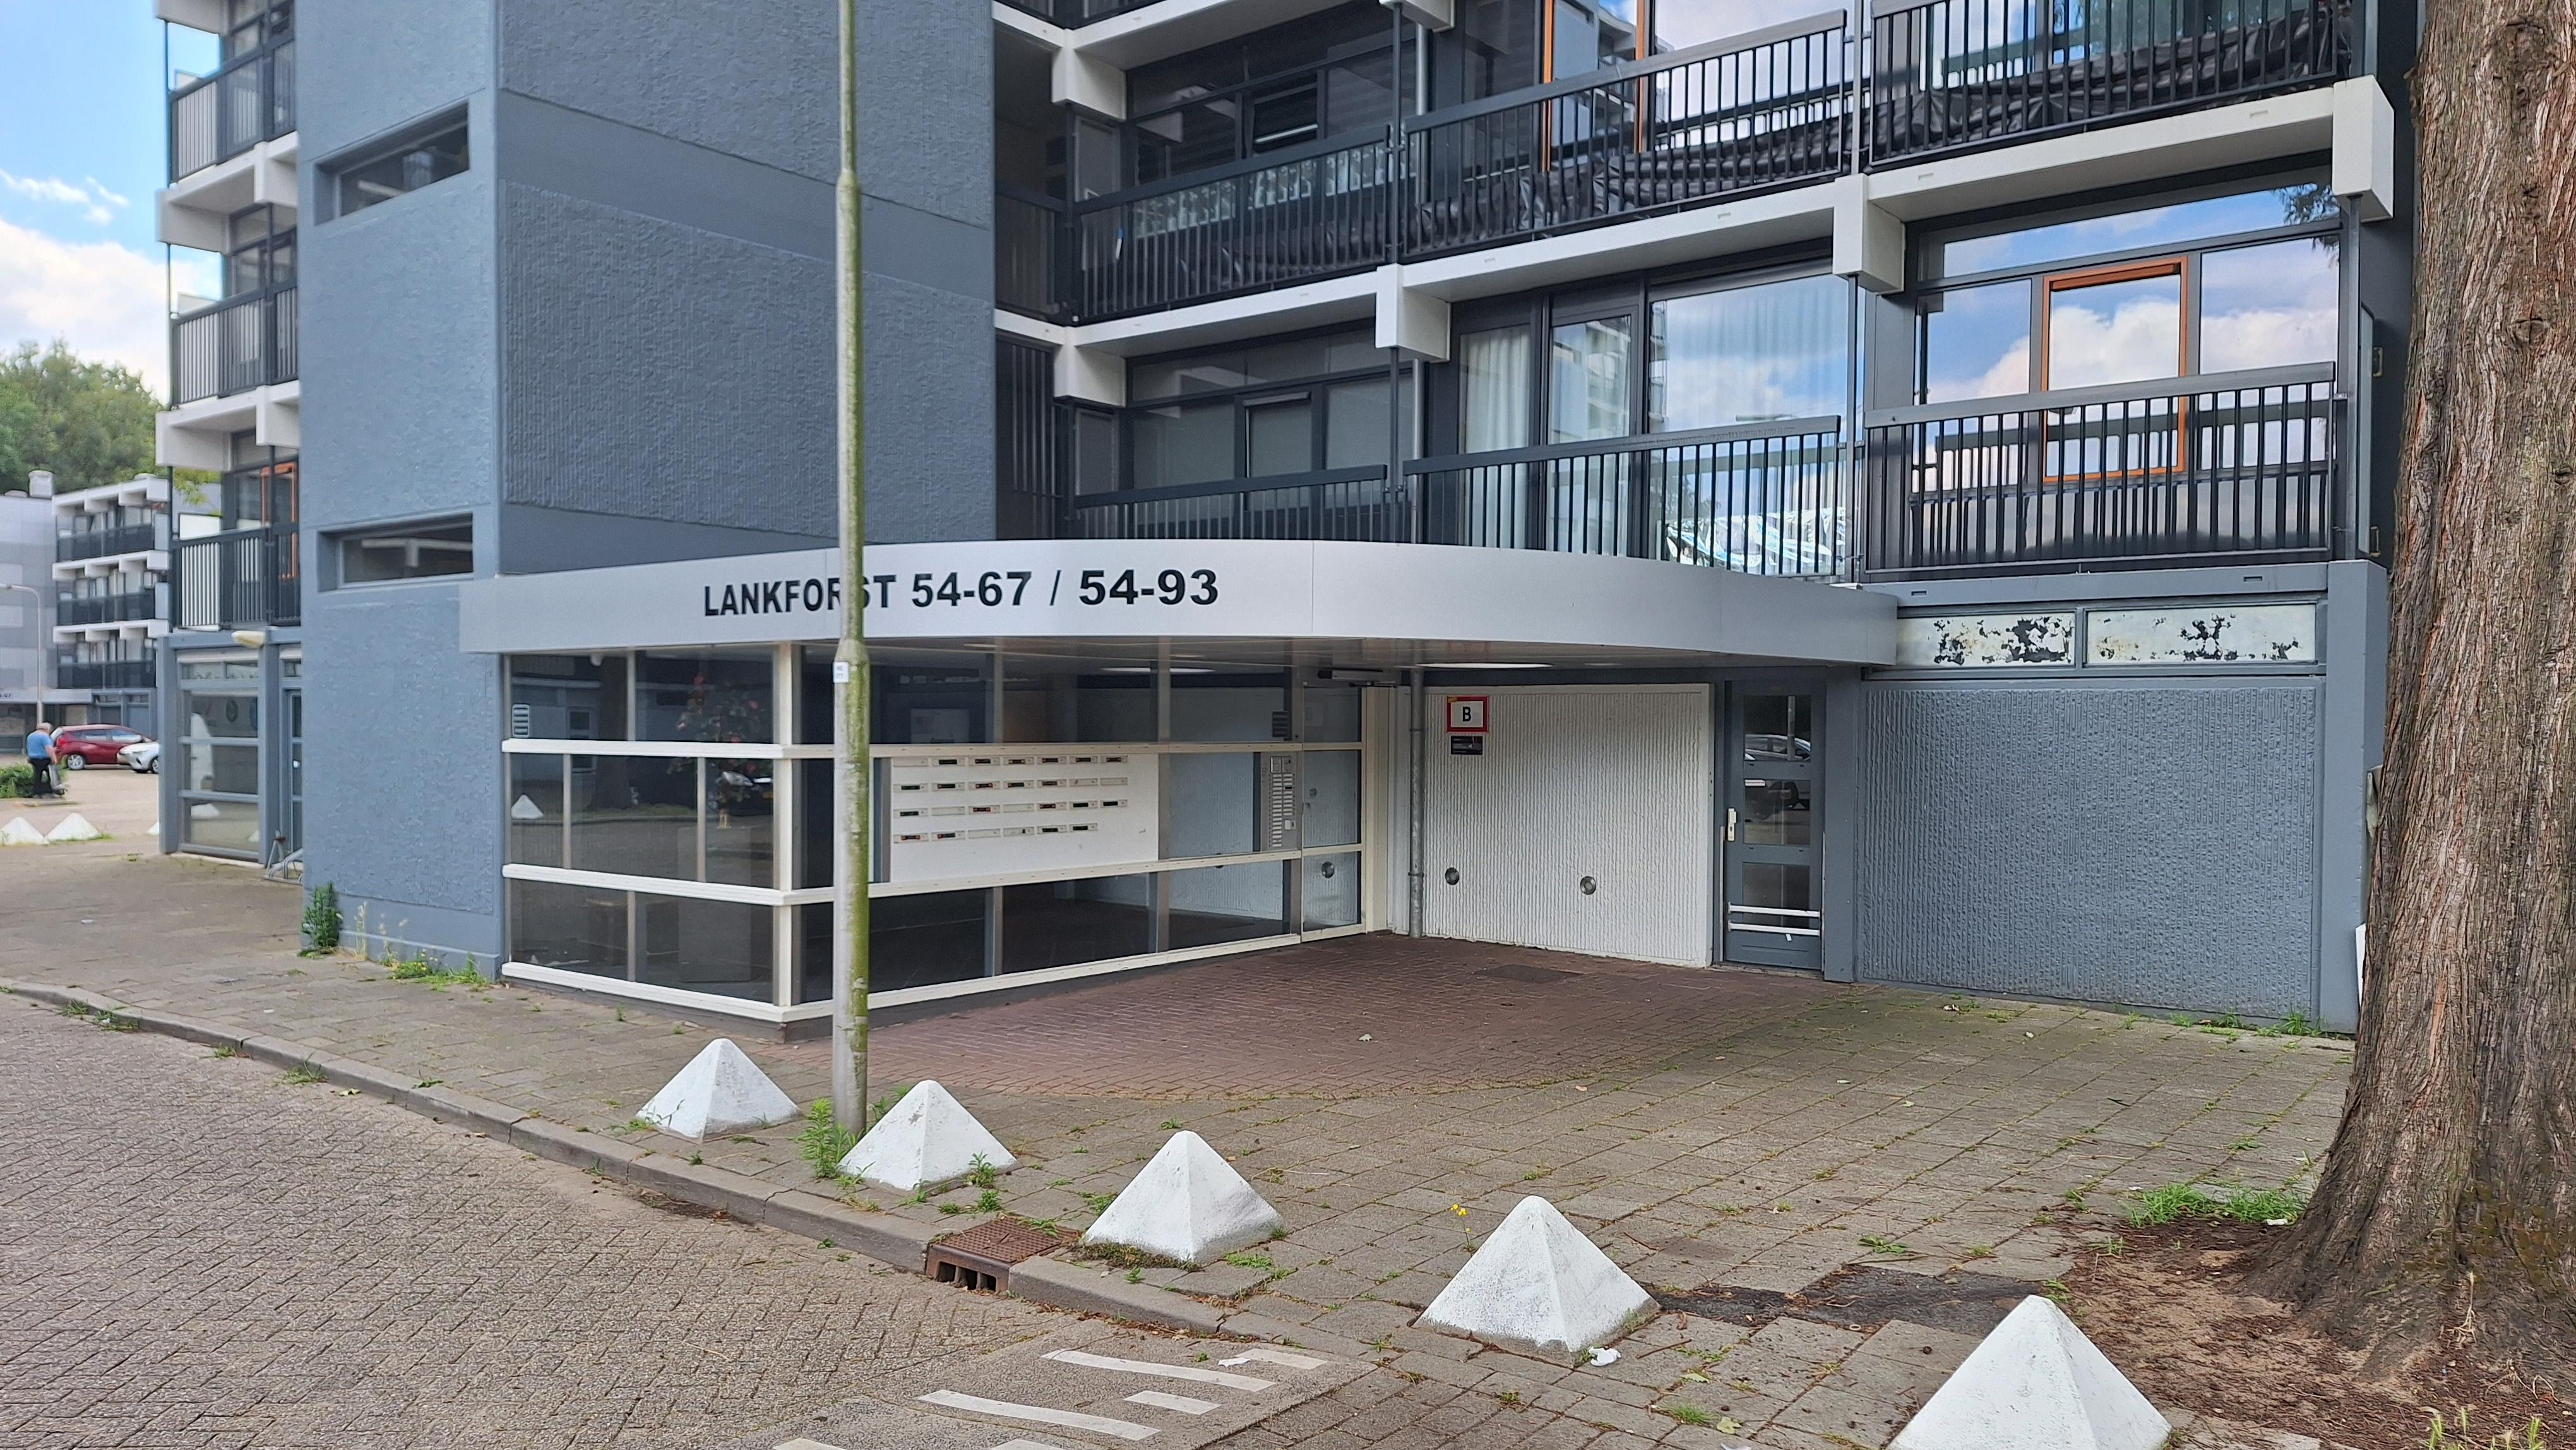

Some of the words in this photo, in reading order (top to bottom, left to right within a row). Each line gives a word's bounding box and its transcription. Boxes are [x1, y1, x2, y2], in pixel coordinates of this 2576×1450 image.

[911, 572, 1032, 607] 54-67
[1049, 570, 1061, 606] /
[1079, 569, 1219, 605] 54-93
[1462, 706, 1472, 722] B
